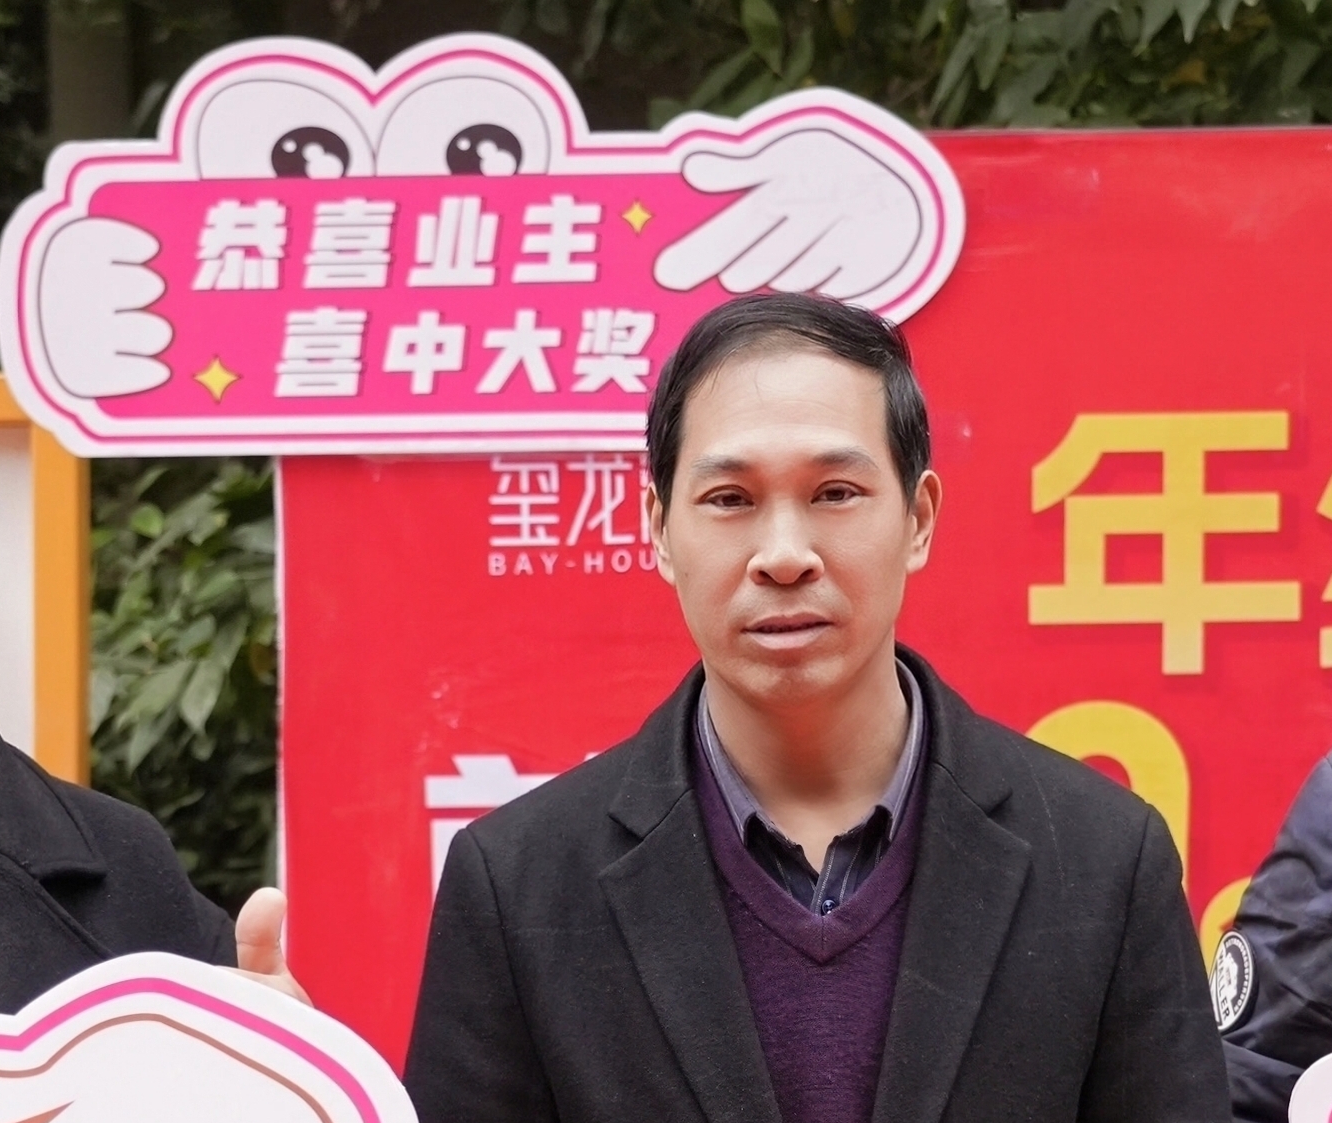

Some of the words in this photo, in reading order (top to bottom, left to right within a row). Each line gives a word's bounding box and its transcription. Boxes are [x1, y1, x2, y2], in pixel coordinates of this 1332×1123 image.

[190, 193, 604, 291] 恭喜业主
[273, 305, 657, 398] 喜中大奖
[488, 453, 651, 547] 玺龙
